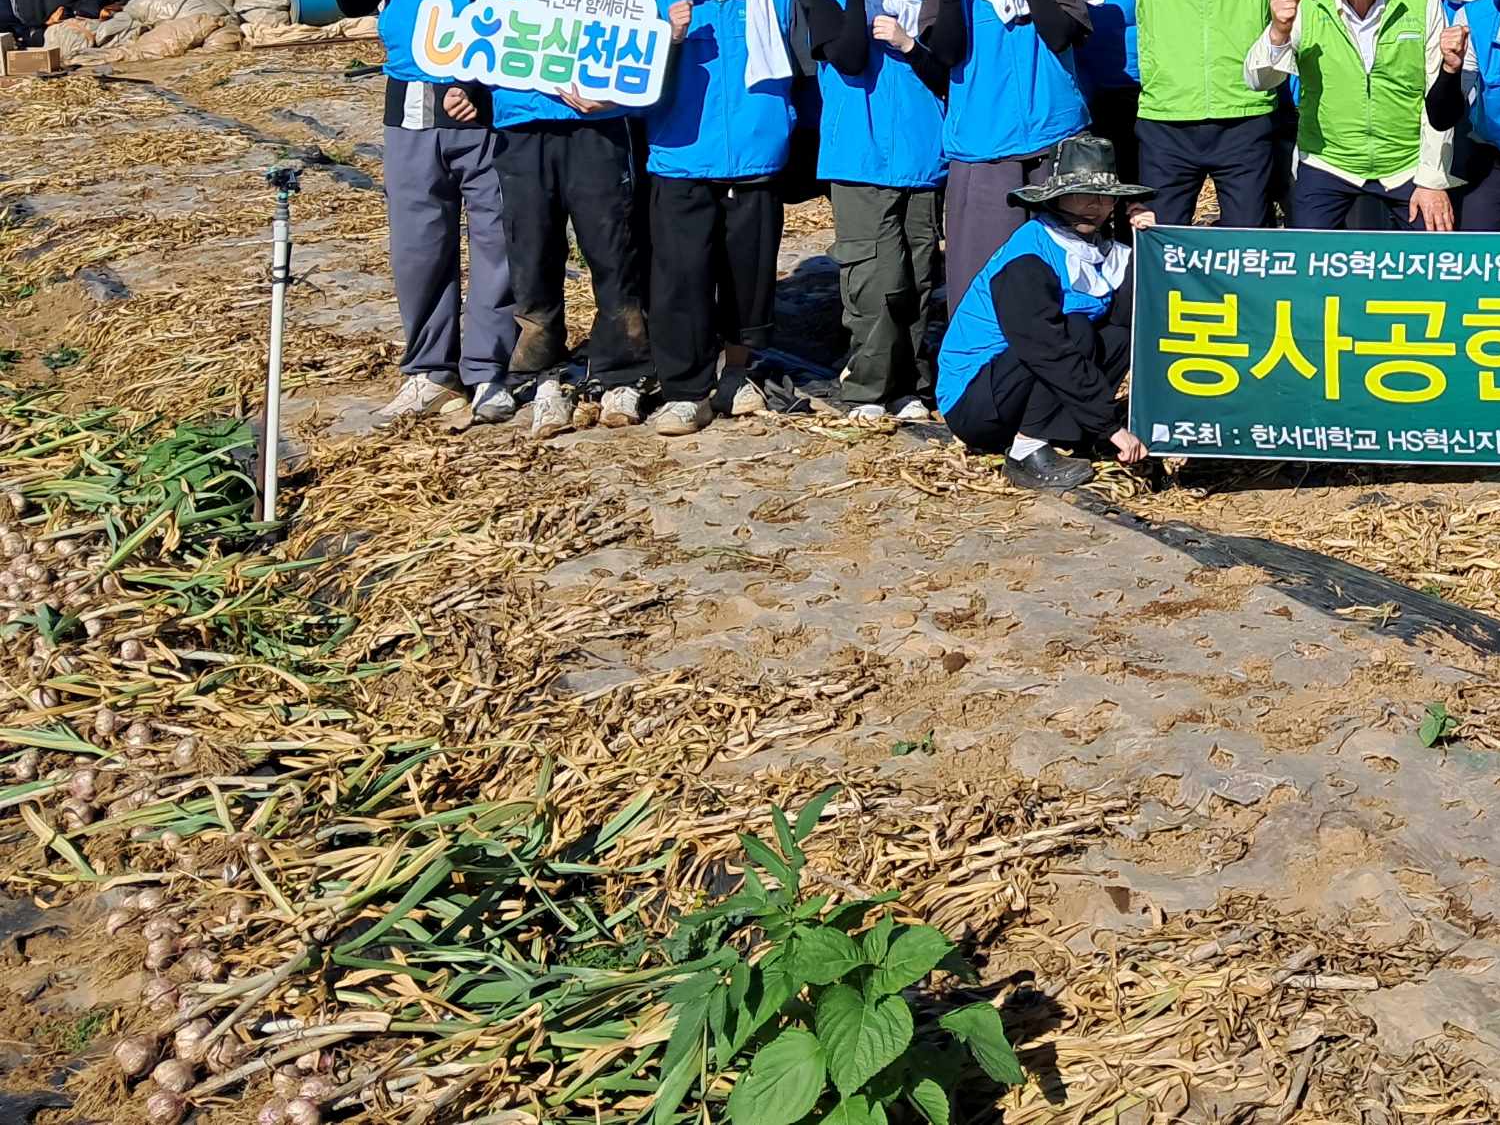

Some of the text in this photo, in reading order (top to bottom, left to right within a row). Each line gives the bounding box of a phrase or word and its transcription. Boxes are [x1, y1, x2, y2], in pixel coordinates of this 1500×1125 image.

[500, 9, 658, 94] 농심천심
[1163, 244, 1297, 278] 한서대학교
[1172, 421, 1222, 447] 주최
[1250, 424, 1380, 451] 한서대학교
